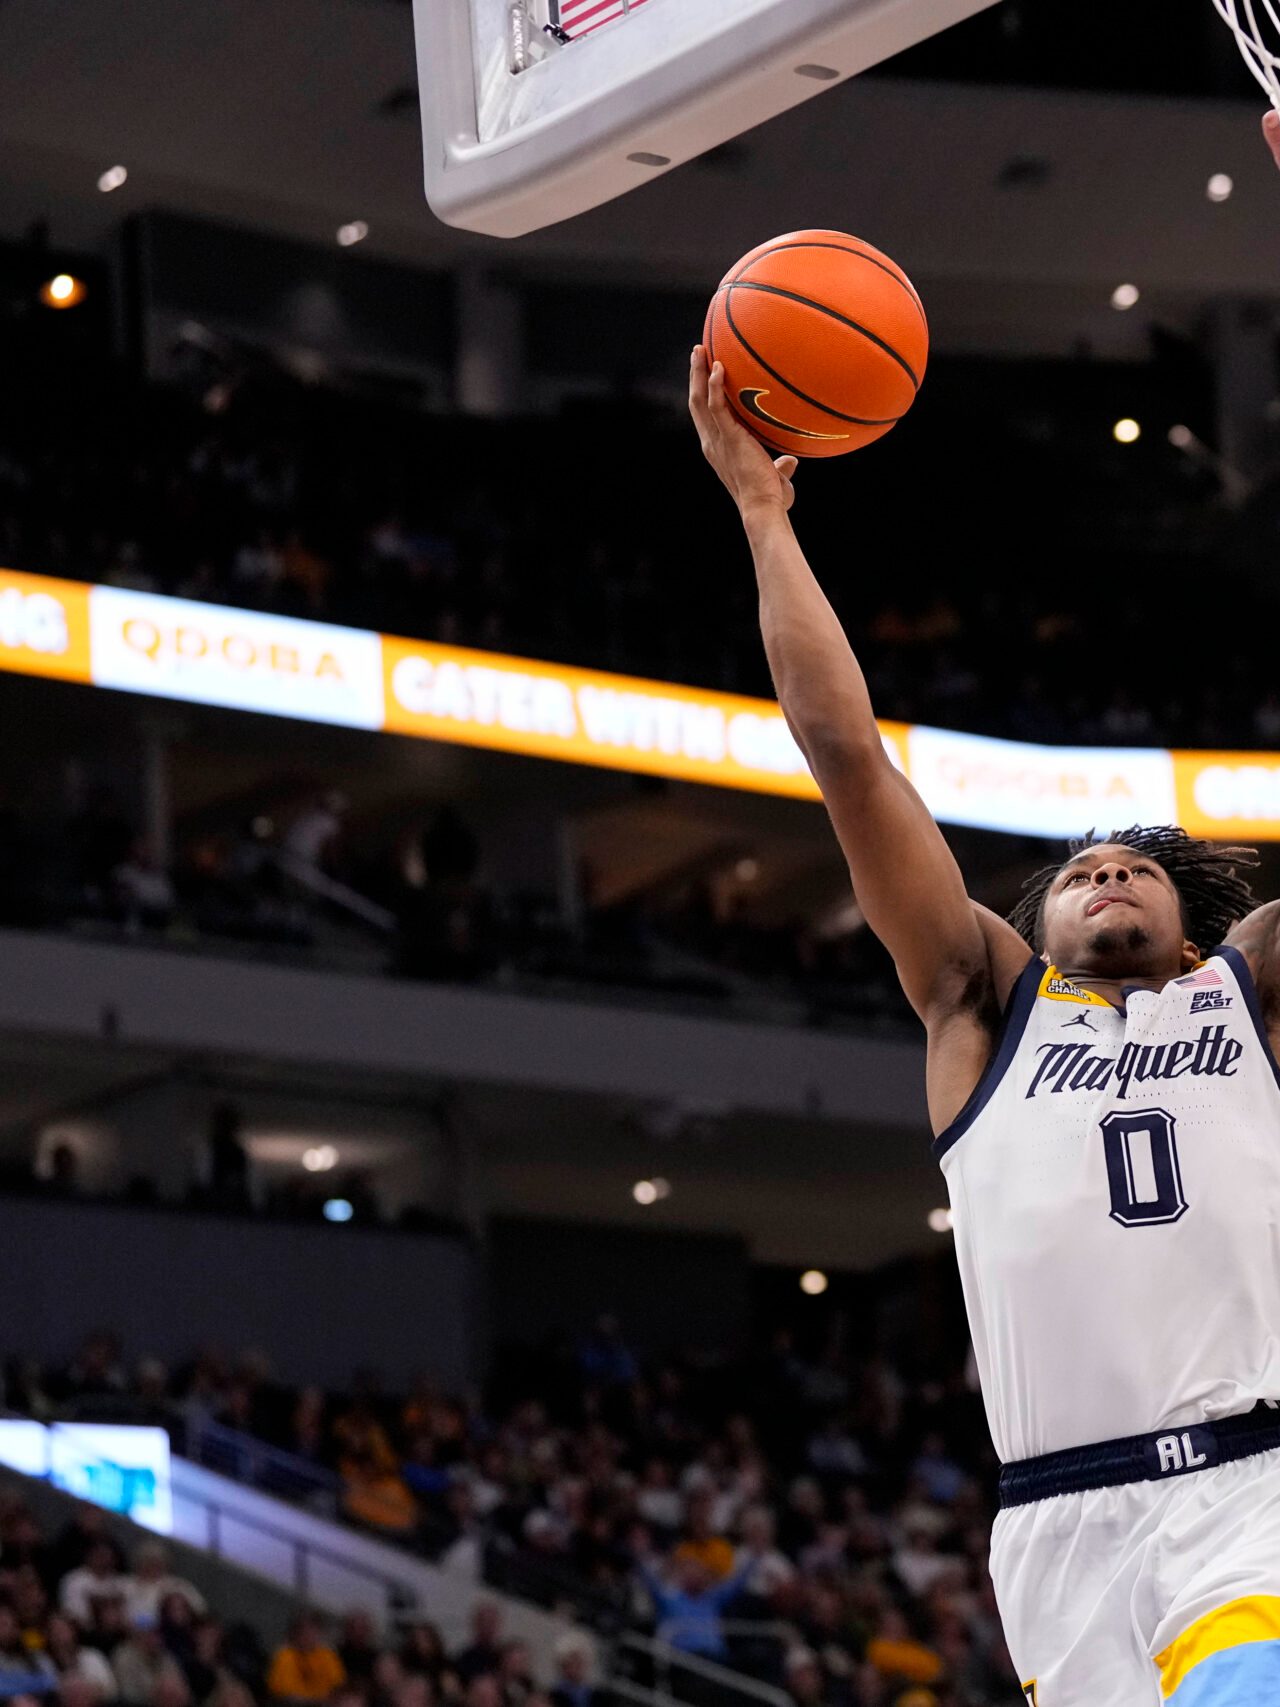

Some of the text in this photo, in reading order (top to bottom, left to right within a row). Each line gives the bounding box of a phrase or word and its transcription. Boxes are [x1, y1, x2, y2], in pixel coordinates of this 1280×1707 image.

[121, 617, 344, 681] QDOBA
[391, 655, 576, 738] CATER
[576, 685, 727, 763] WITH
[1190, 997, 1233, 1010] EAST
[1192, 990, 1222, 1002] BIG
[1099, 1107, 1189, 1228] 0
[1155, 1432, 1207, 1472] AL
